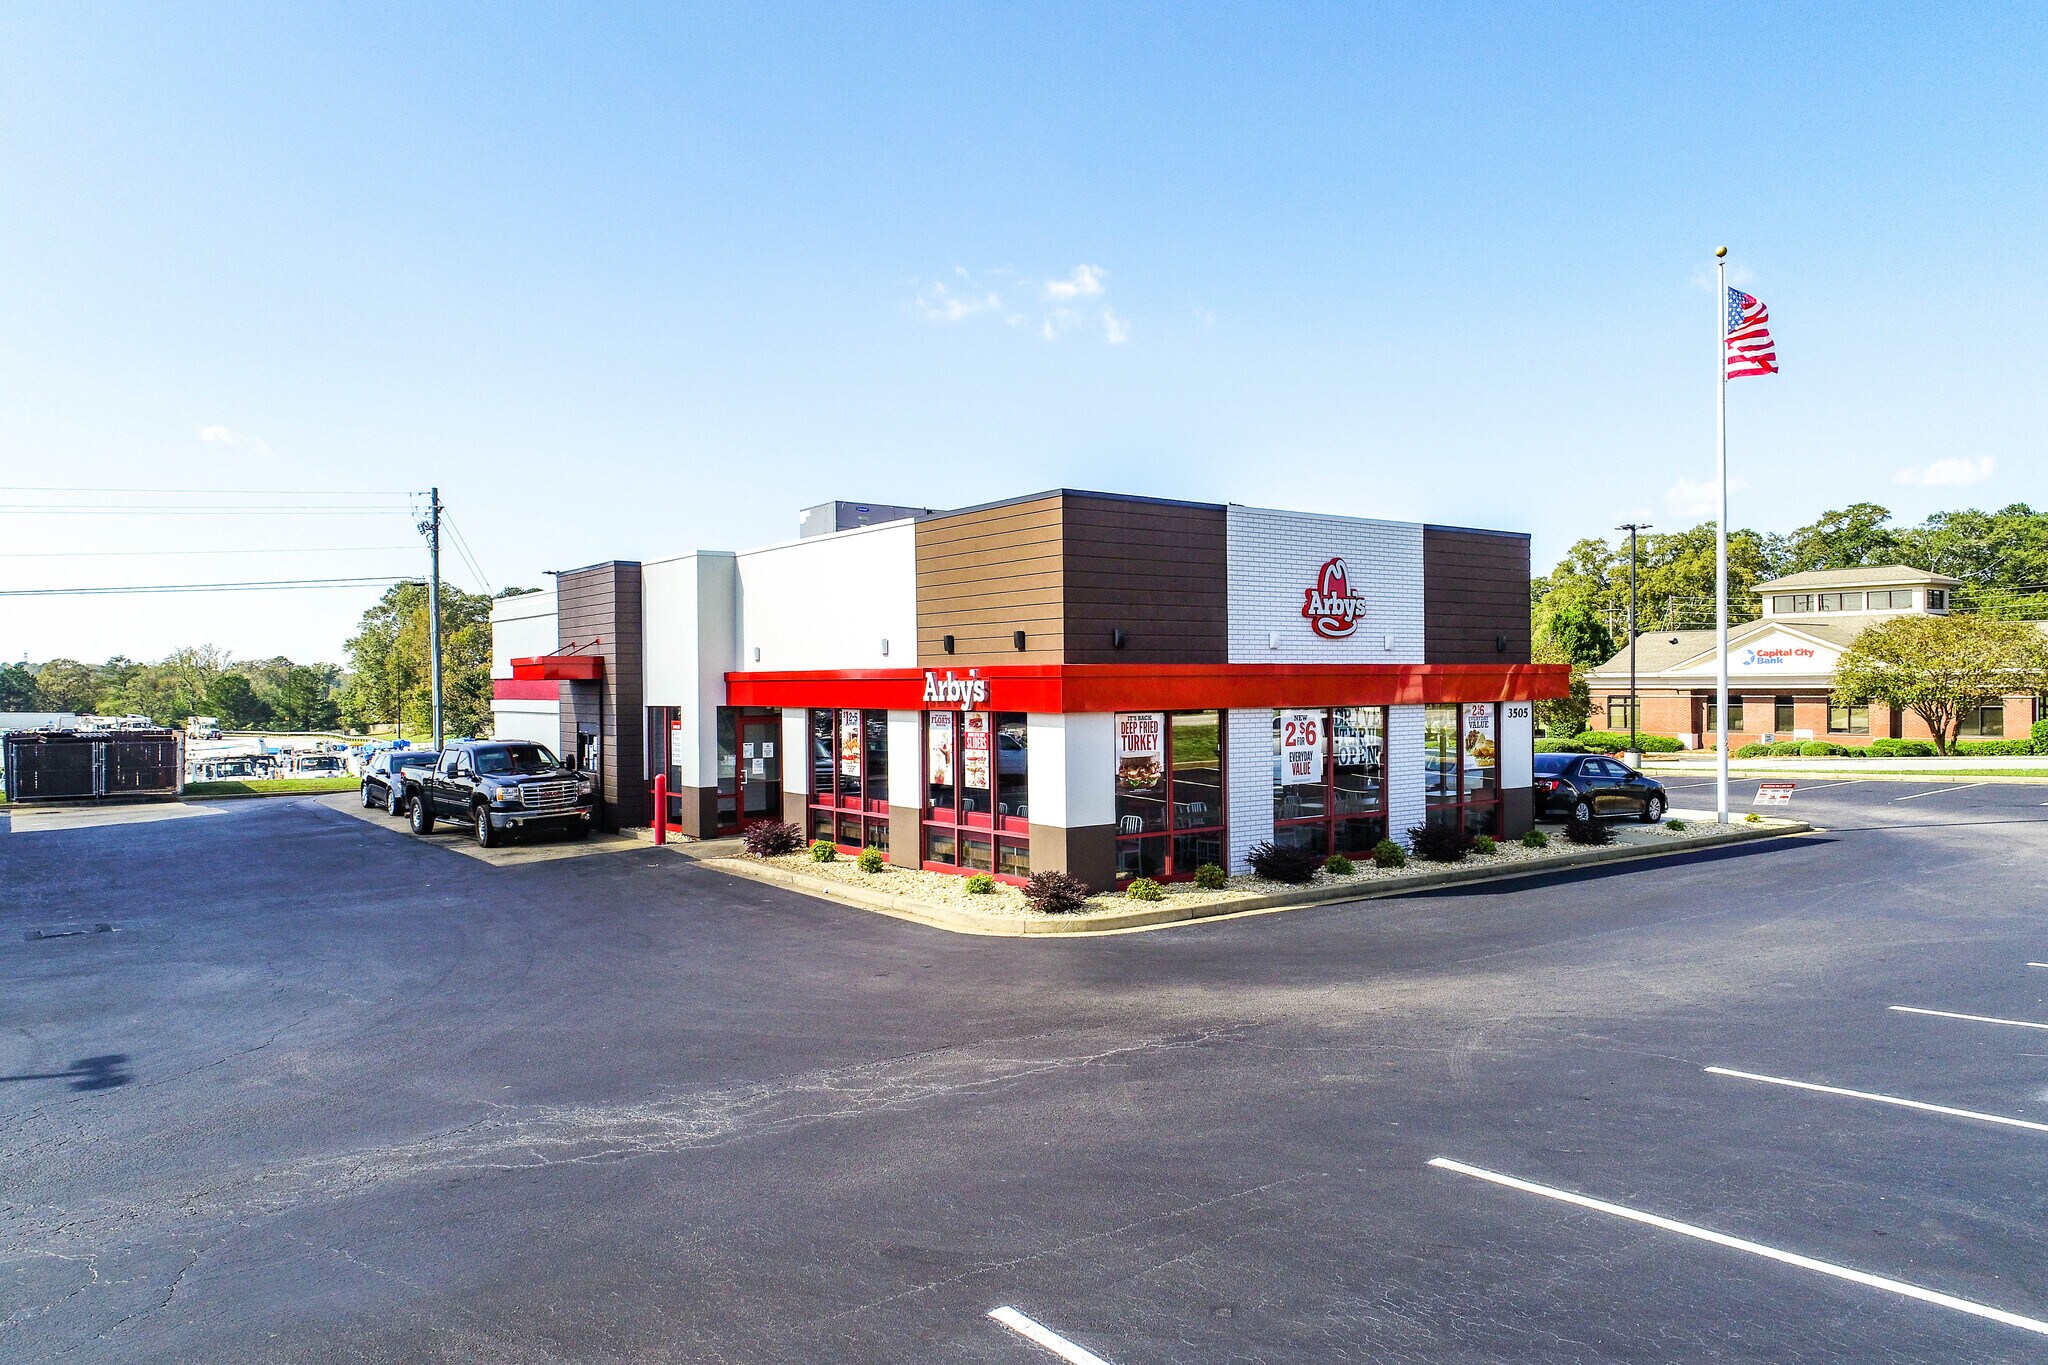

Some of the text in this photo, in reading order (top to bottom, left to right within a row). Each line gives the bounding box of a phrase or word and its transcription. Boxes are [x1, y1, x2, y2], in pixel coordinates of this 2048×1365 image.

[1308, 590, 1365, 622] Arby's
[1757, 648, 1815, 658] Capital City
[923, 669, 986, 712] Arby's
[1333, 708, 1380, 727] DRIVE
[1507, 707, 1529, 718] 3505
[1121, 720, 1159, 735] DEEP FRIED
[1468, 721, 1490, 729] VALUE
[1285, 721, 1297, 747] 2
[966, 736, 987, 750] SLIDERS
[1121, 733, 1158, 752] TURKEY
[1289, 750, 1313, 763] EVERYDAY
[1339, 745, 1379, 765] OPEN
[1291, 762, 1311, 776] VALUE
